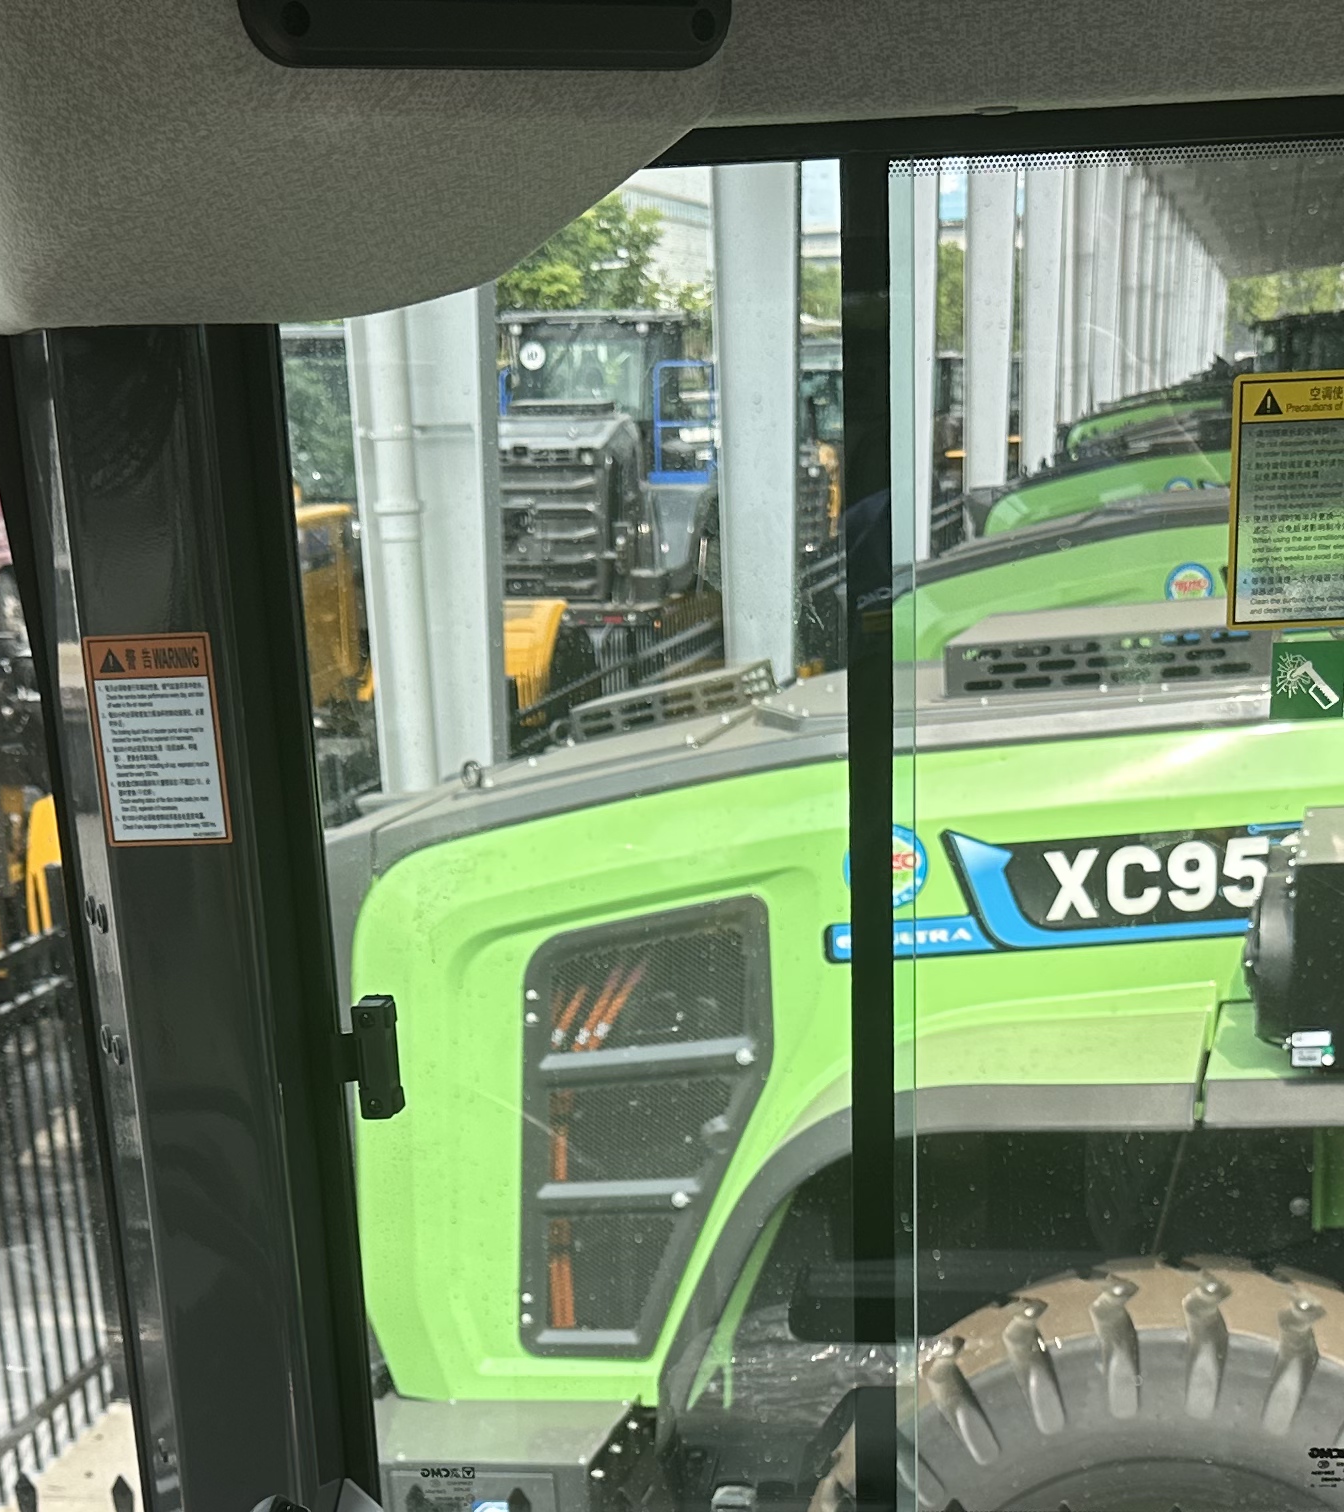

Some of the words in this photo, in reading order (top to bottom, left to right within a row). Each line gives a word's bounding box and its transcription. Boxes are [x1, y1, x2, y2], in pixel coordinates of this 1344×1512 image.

[1286, 401, 1332, 413] Precautions
[1334, 400, 1343, 411] of
[1284, 554, 1304, 562] weeks
[151, 646, 199, 669] WARNING
